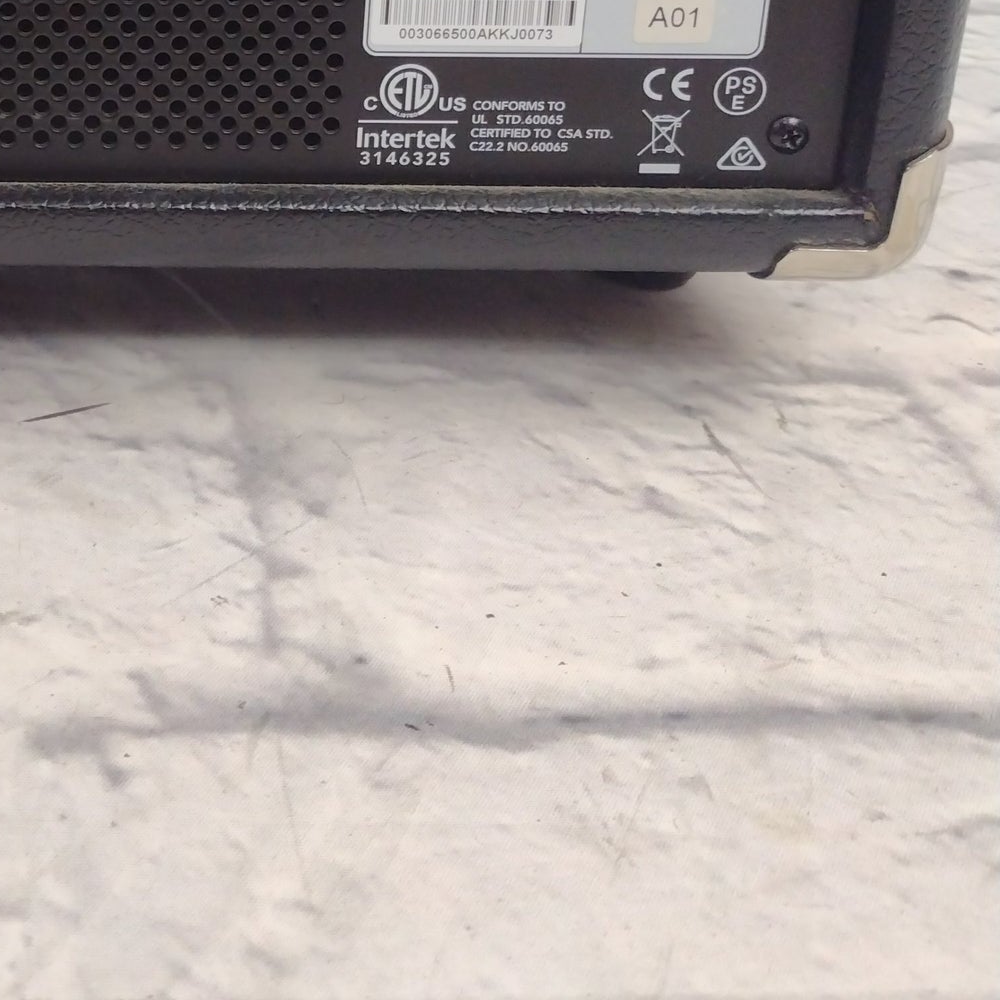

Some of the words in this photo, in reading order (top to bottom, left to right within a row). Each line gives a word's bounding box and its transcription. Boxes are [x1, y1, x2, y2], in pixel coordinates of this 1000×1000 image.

[648, 7, 699, 28] A01
[399, 28, 553, 40] 003066500AKKJ0073
[643, 68, 694, 101] CE
[473, 101, 544, 111] CONFORMS
[548, 101, 566, 111] TO
[471, 115, 487, 125] UL
[497, 115, 563, 125] STD.60065
[357, 127, 456, 149] Intertek
[470, 129, 531, 138] CERTIFIED
[534, 129, 551, 139] TO
[557, 129, 582, 139] CSA
[586, 129, 613, 139] STD.
[469, 142, 503, 151] C22.2
[508, 142, 568, 152] NO.60065
[360, 152, 450, 165] 3146325
